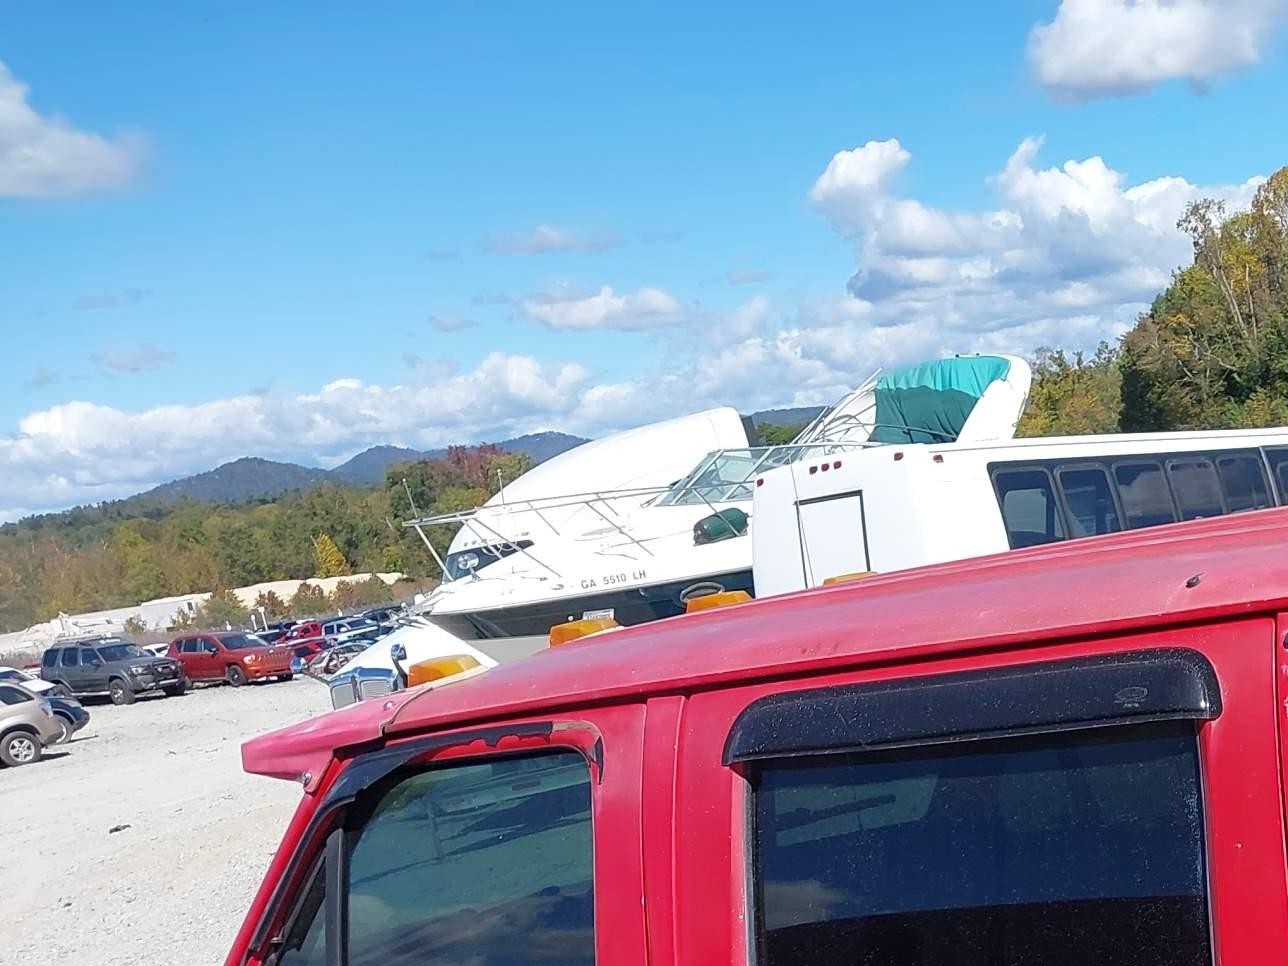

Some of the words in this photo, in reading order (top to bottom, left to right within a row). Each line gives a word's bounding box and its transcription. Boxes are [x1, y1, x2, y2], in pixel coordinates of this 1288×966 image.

[581, 579, 597, 589] GA
[603, 573, 627, 585] 5510
[633, 569, 647, 580] LH
